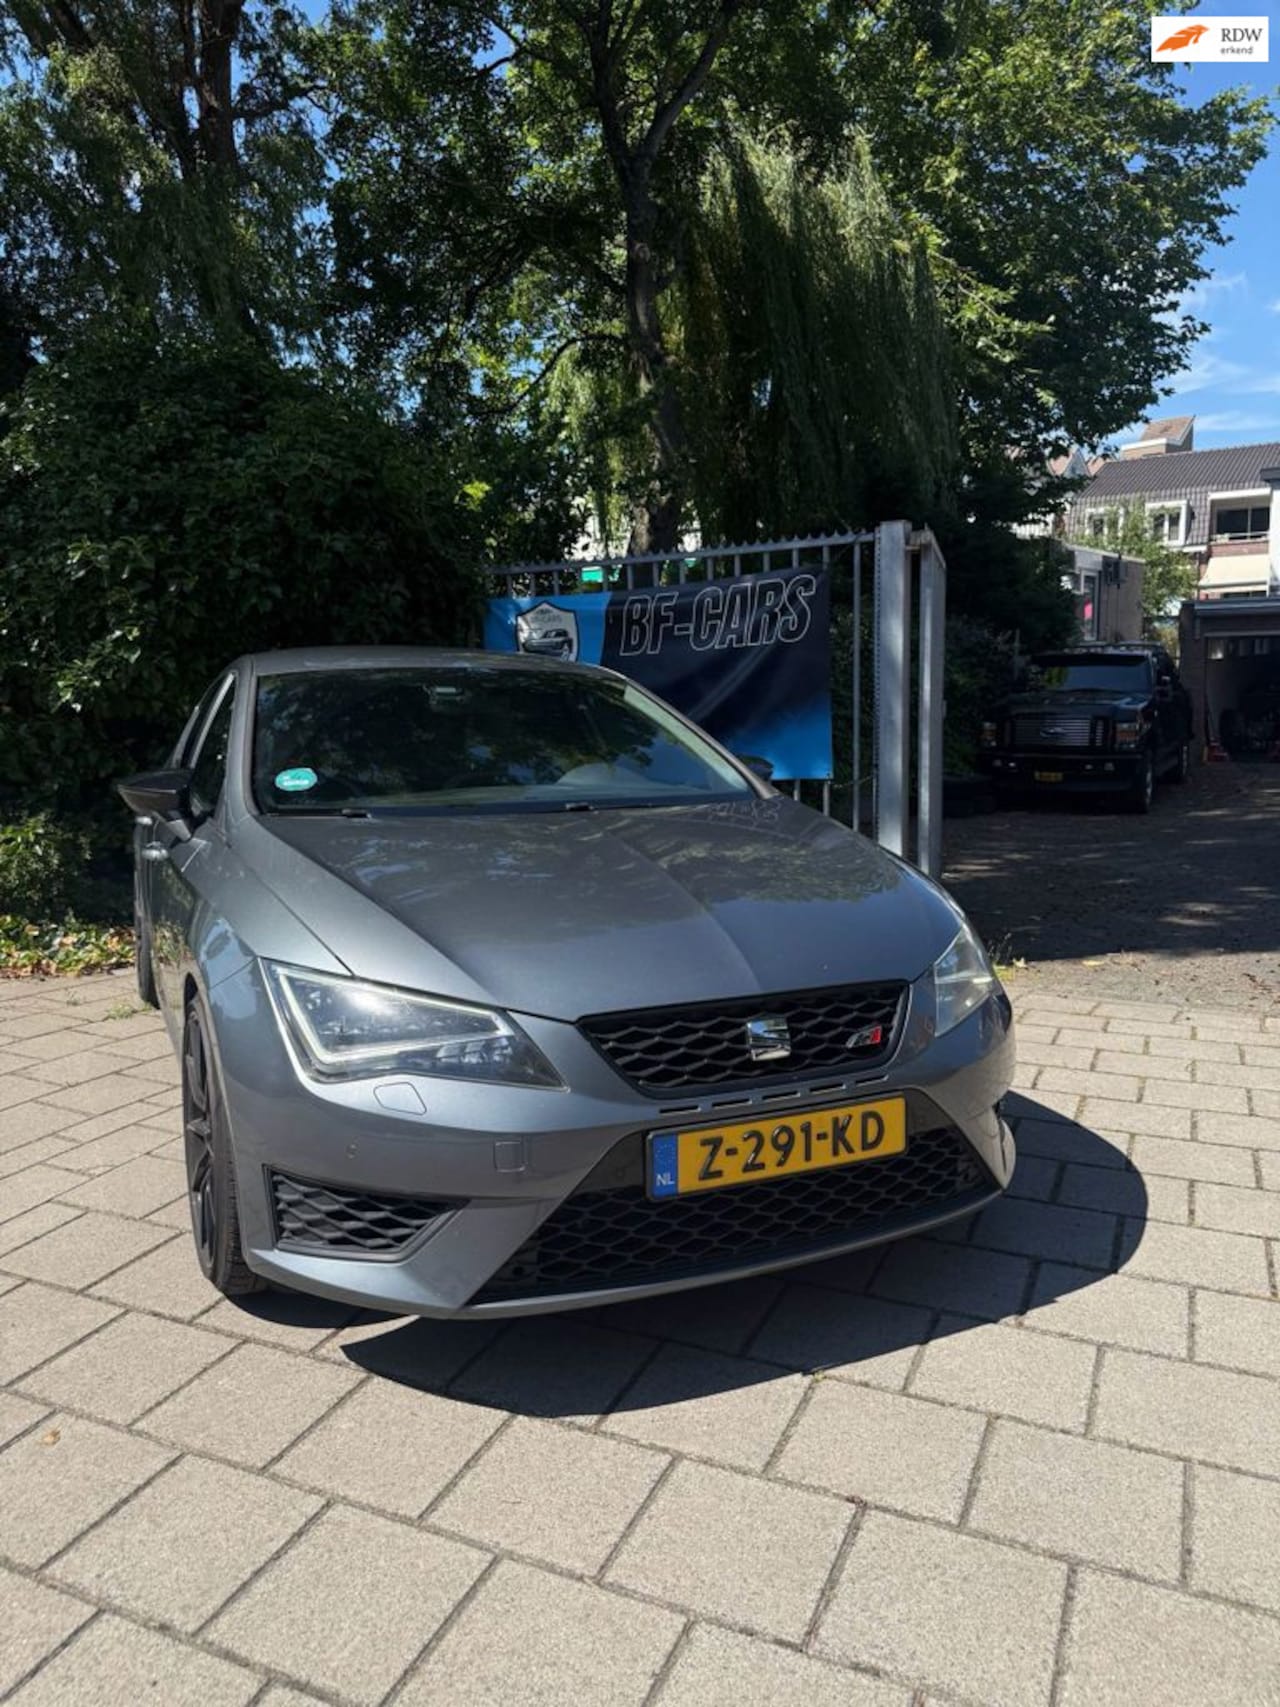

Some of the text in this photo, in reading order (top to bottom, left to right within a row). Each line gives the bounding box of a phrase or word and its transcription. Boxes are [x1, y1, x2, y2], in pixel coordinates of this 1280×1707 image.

[619, 574, 816, 656] BF-CARS
[656, 1172, 675, 1186] NL
[698, 1111, 885, 1181] Z-291-KD
